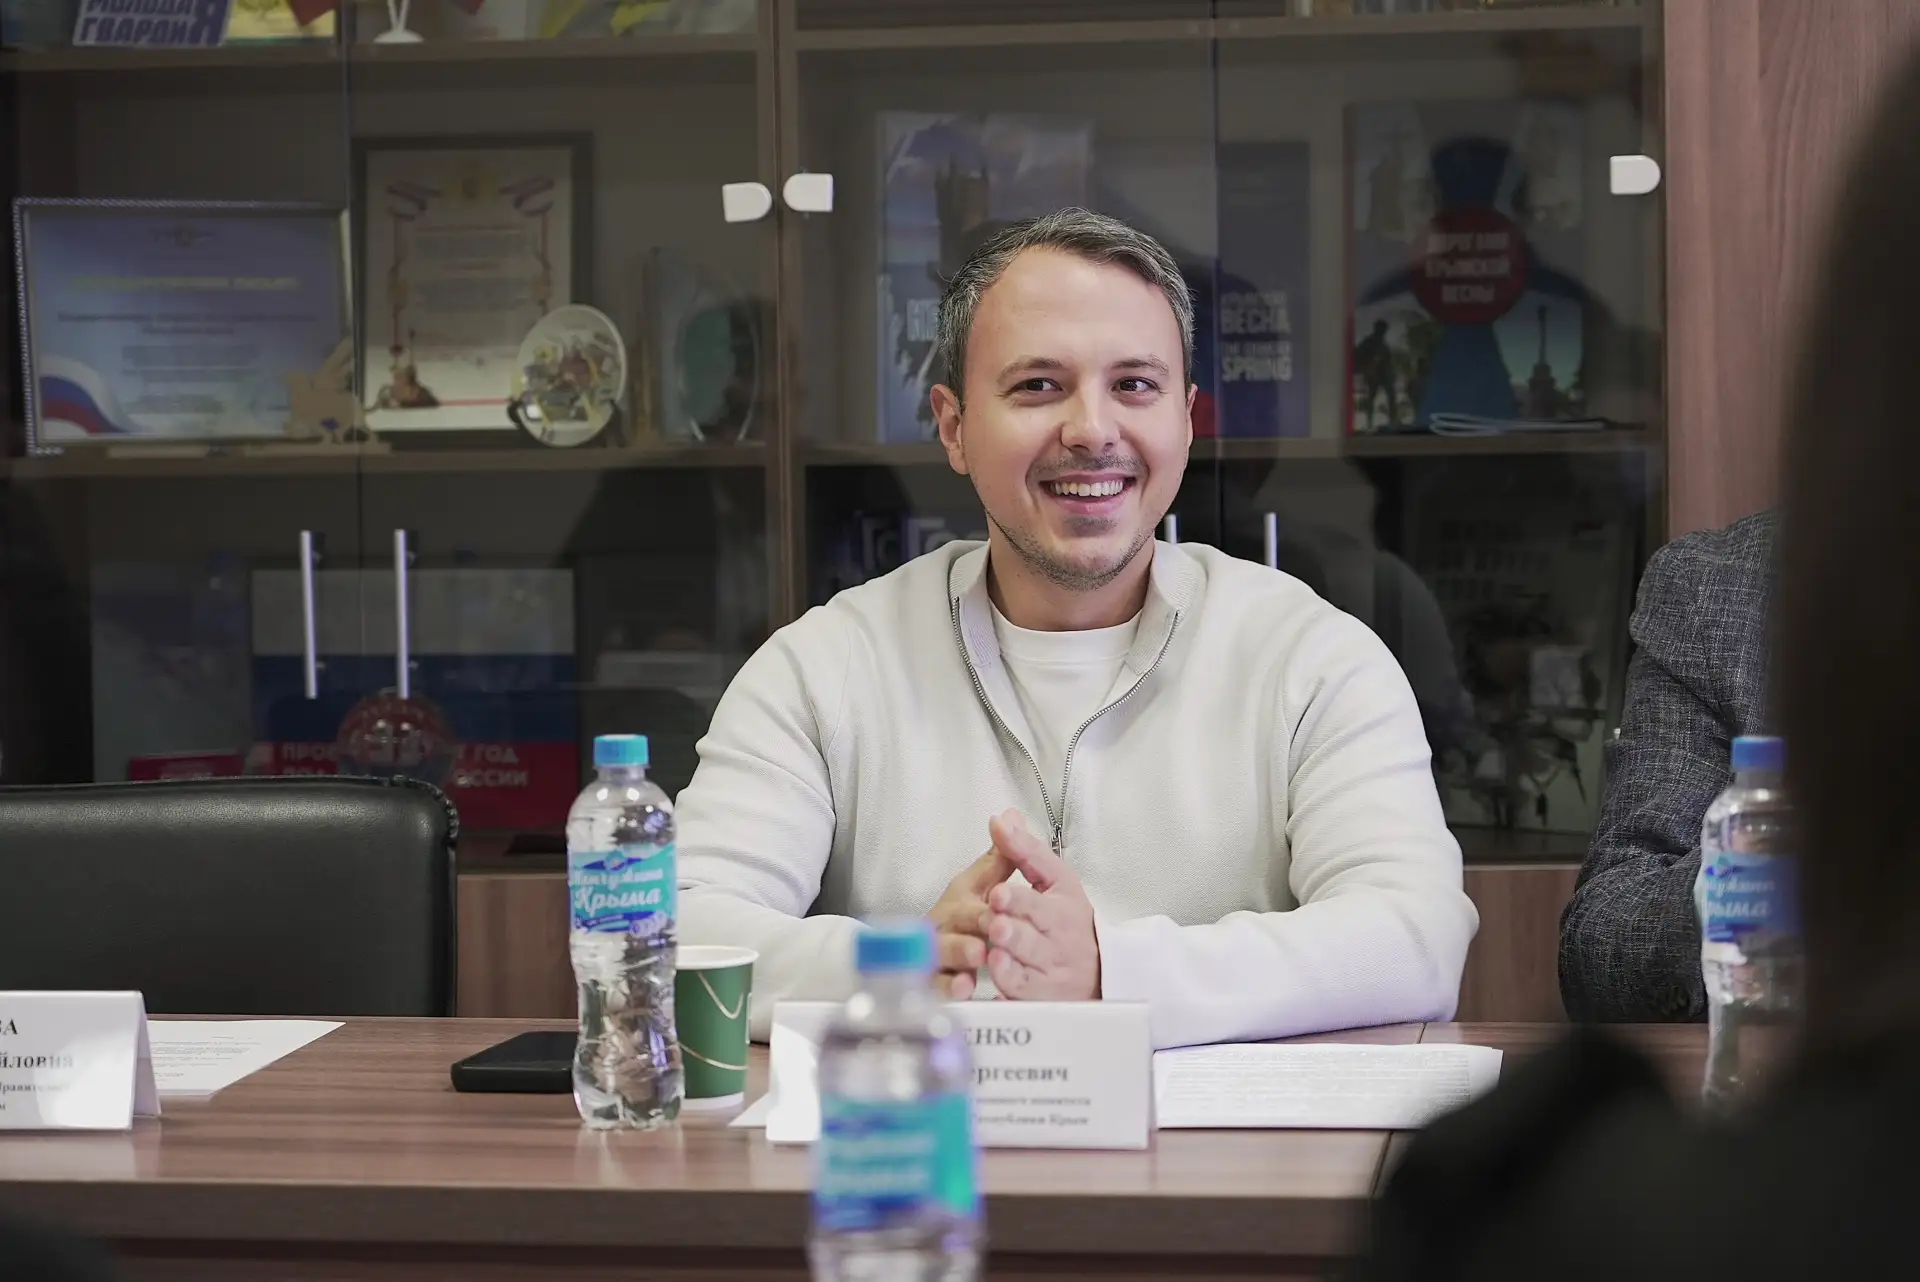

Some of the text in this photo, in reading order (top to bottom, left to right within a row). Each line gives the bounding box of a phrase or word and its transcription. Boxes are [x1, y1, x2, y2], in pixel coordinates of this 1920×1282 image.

[452, 768, 527, 789] ОССИИ
[574, 885, 661, 917] Крыма
[964, 1026, 1032, 1047] ЕНКО
